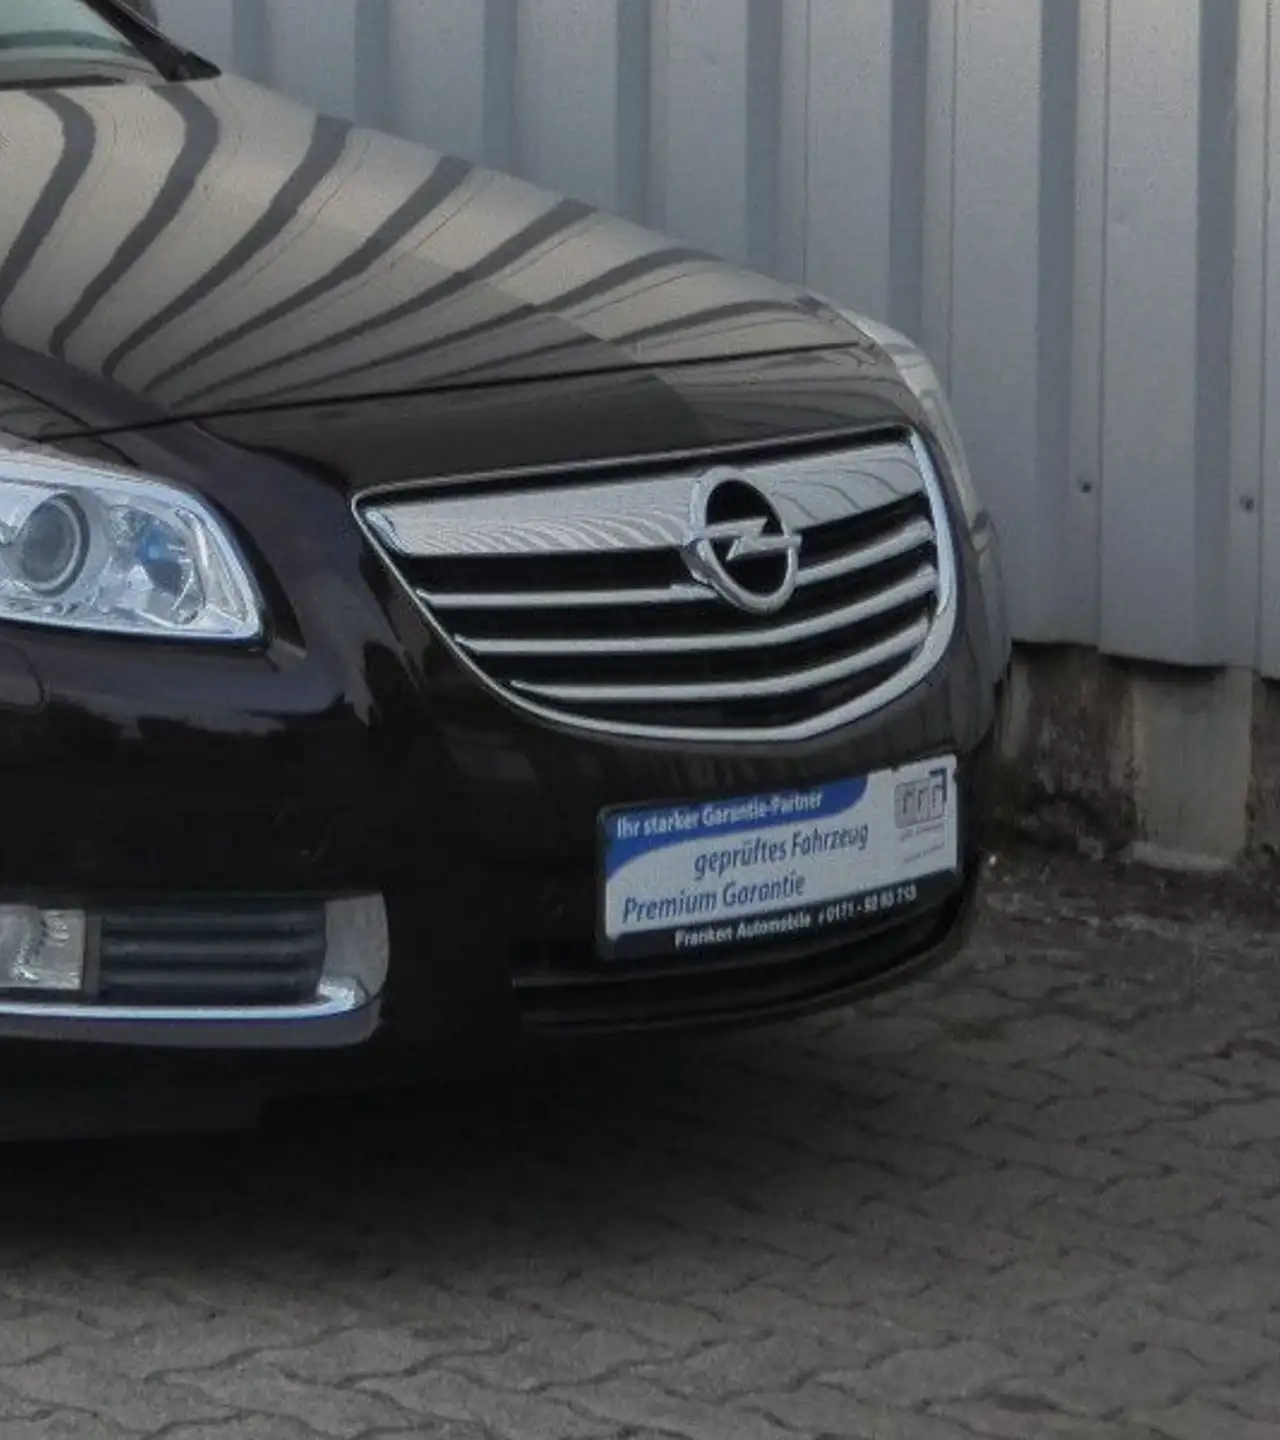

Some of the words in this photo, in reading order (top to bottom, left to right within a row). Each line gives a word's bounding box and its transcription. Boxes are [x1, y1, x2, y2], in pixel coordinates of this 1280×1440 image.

[617, 816, 640, 838] Ihr
[644, 809, 700, 835] starker
[694, 837, 787, 881] geprüftes
[791, 823, 869, 858] Fahrzeug
[622, 888, 718, 925] Premium
[722, 868, 806, 908] Garantie
